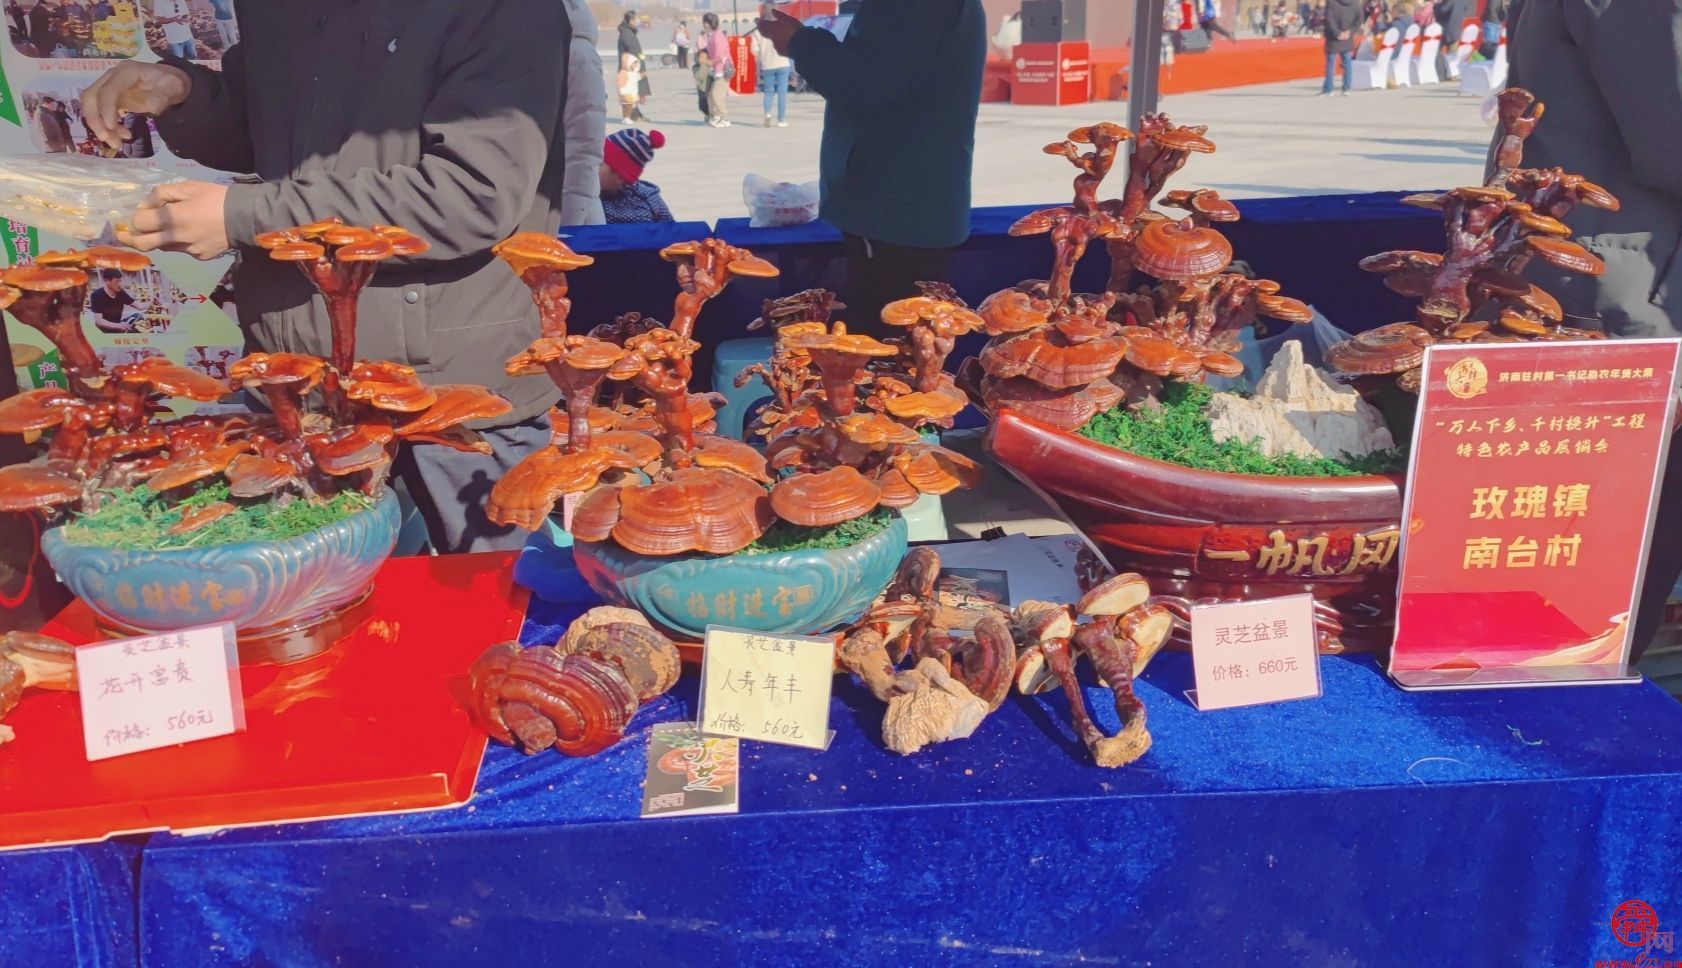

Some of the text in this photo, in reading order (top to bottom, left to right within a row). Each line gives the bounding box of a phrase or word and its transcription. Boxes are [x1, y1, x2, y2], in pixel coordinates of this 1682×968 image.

[1498, 367, 1655, 383] 济南驻村第一书记助农年货大集
[1455, 437, 1611, 459] 特色农产品展销会
[1469, 483, 1592, 521] 玫瑰镇
[1462, 533, 1583, 570] 南台村
[1215, 618, 1289, 646] 灵芝盆景
[743, 634, 798, 657] 灵芝盆景
[97, 658, 195, 700] 花开富贵
[1211, 656, 1299, 681] 价格：660元
[720, 667, 803, 705] 人寿年丰
[167, 709, 214, 731] 560元
[762, 717, 804, 740] 560元
